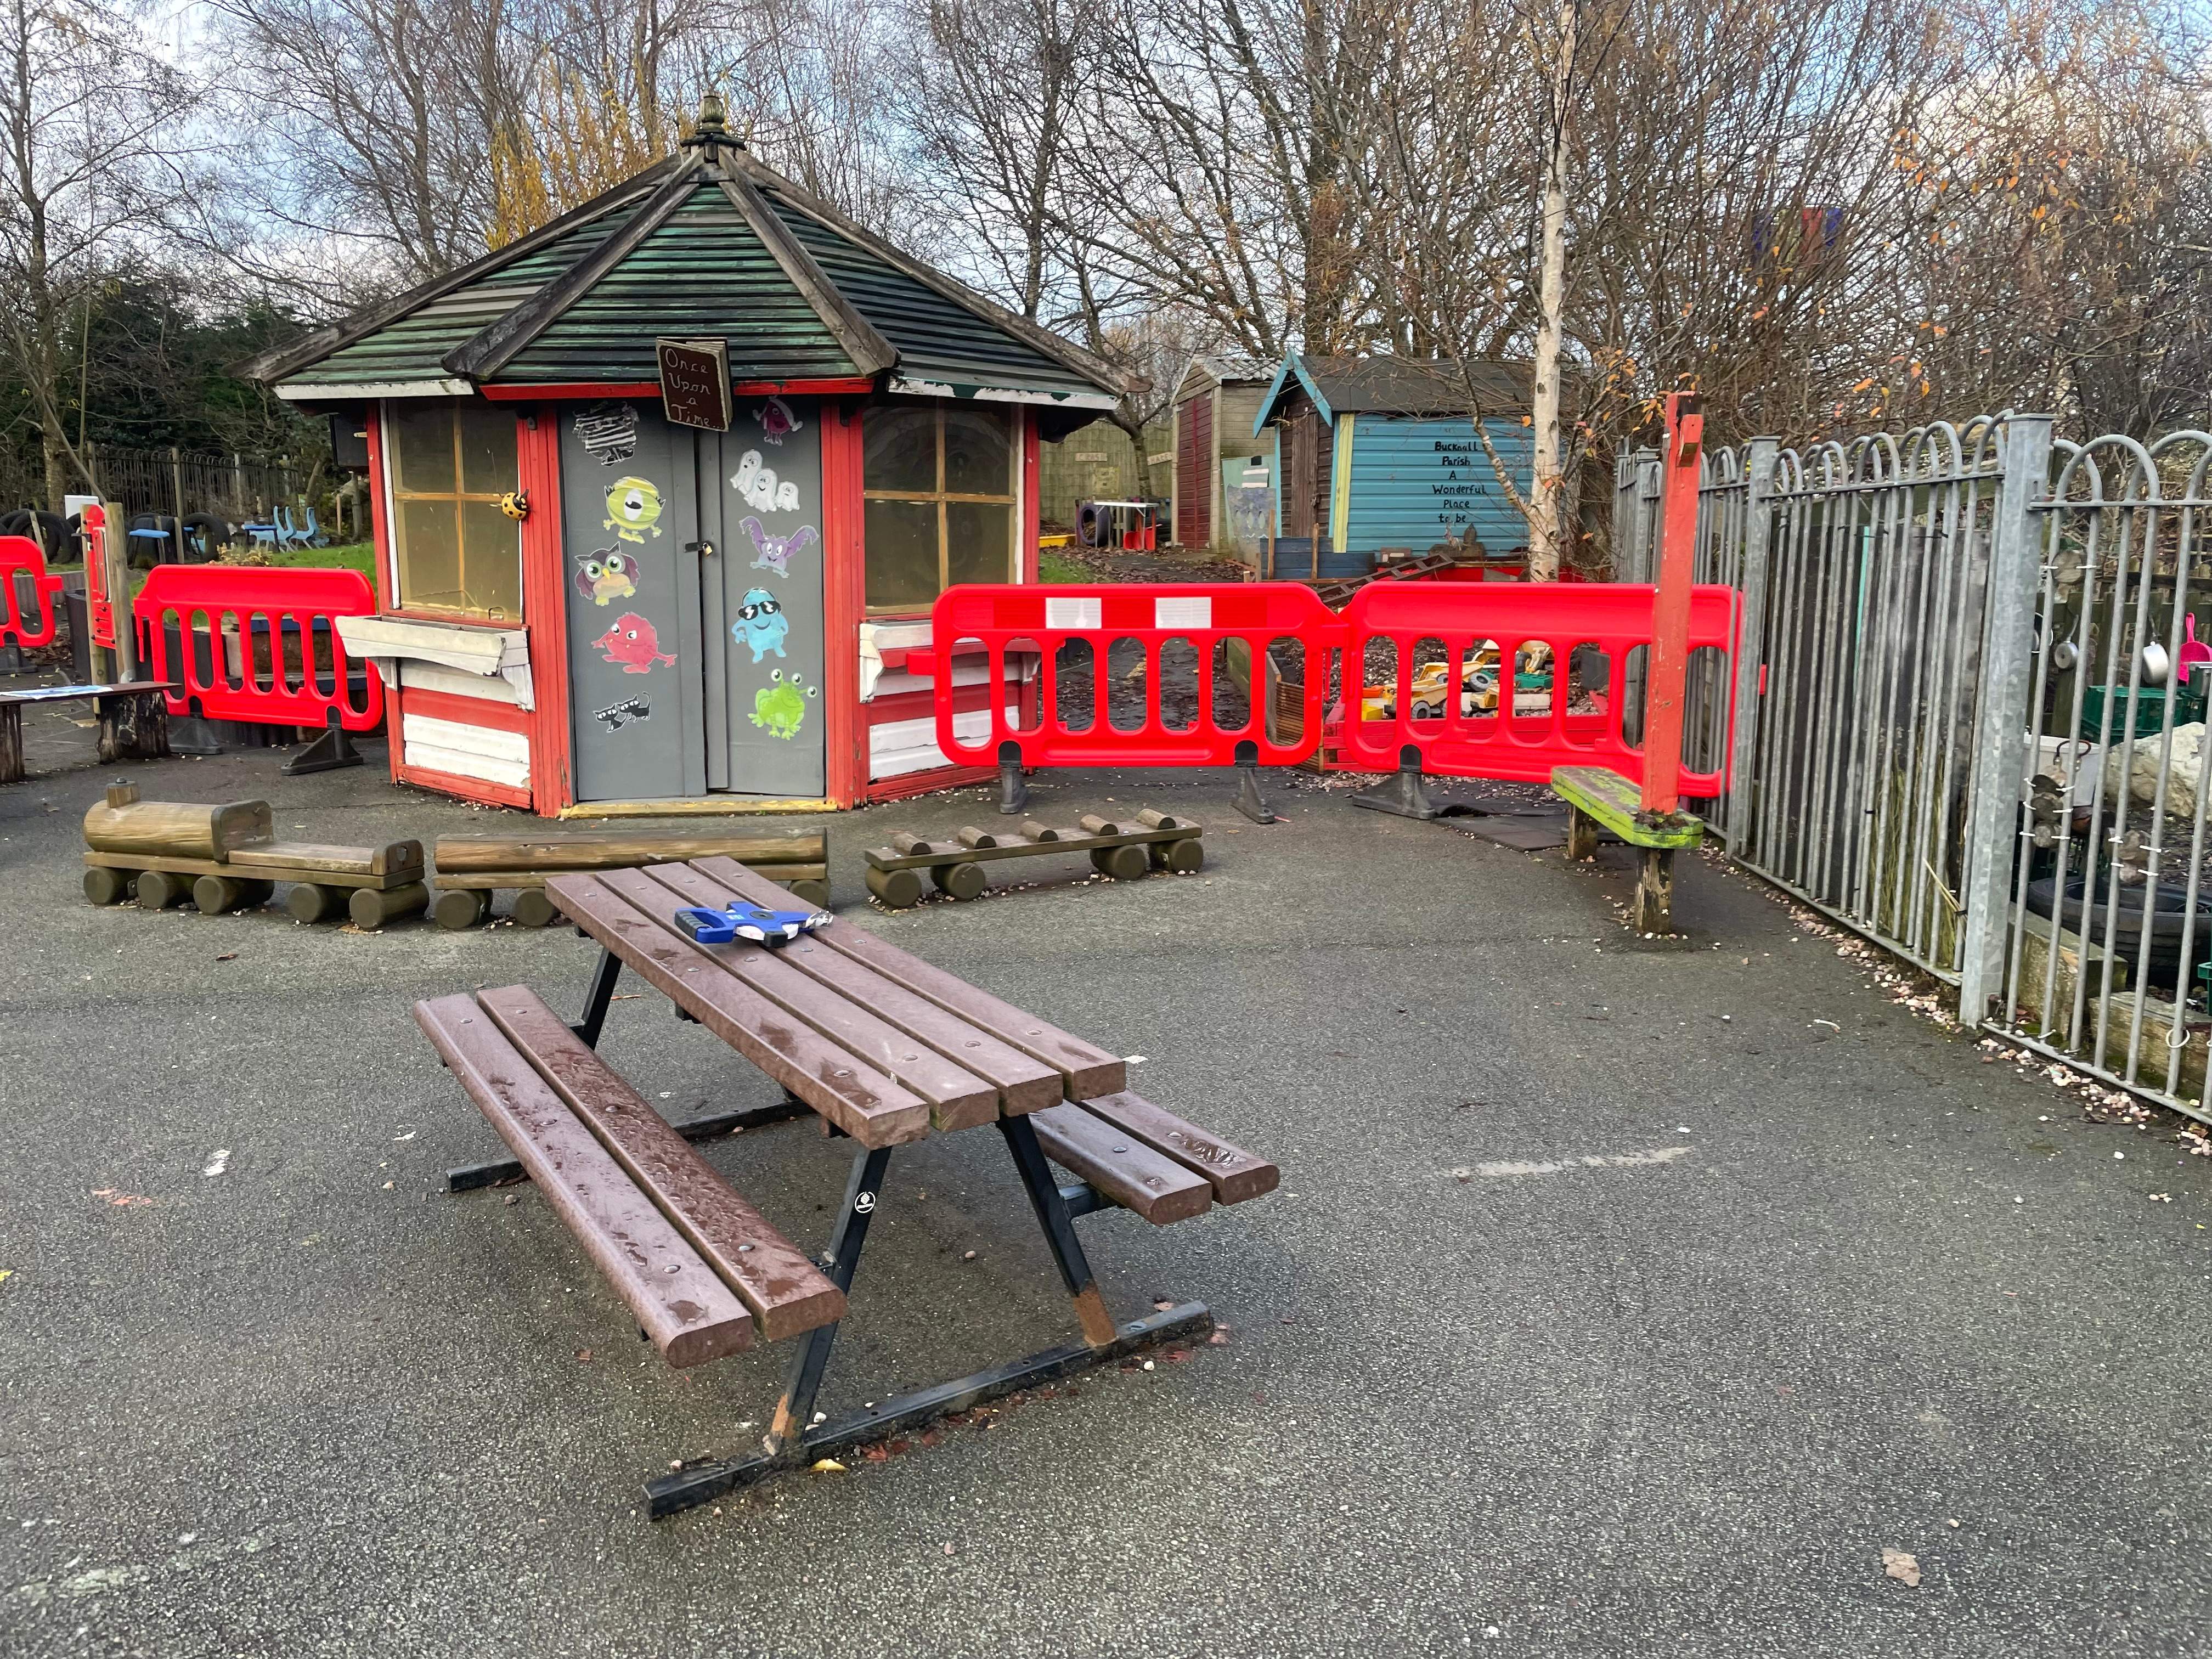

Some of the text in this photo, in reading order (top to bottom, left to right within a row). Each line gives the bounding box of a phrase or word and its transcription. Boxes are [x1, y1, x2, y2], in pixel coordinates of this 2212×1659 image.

[665, 348, 708, 374] Once
[668, 373, 710, 395] Upon
[686, 397, 698, 405] a
[1435, 441, 1478, 452] Bucknall
[1442, 456, 1471, 466] Parish
[1449, 470, 1457, 480] A
[1432, 484, 1486, 494] Wonderful
[1443, 499, 1470, 509] Place
[1455, 513, 1466, 523] be
